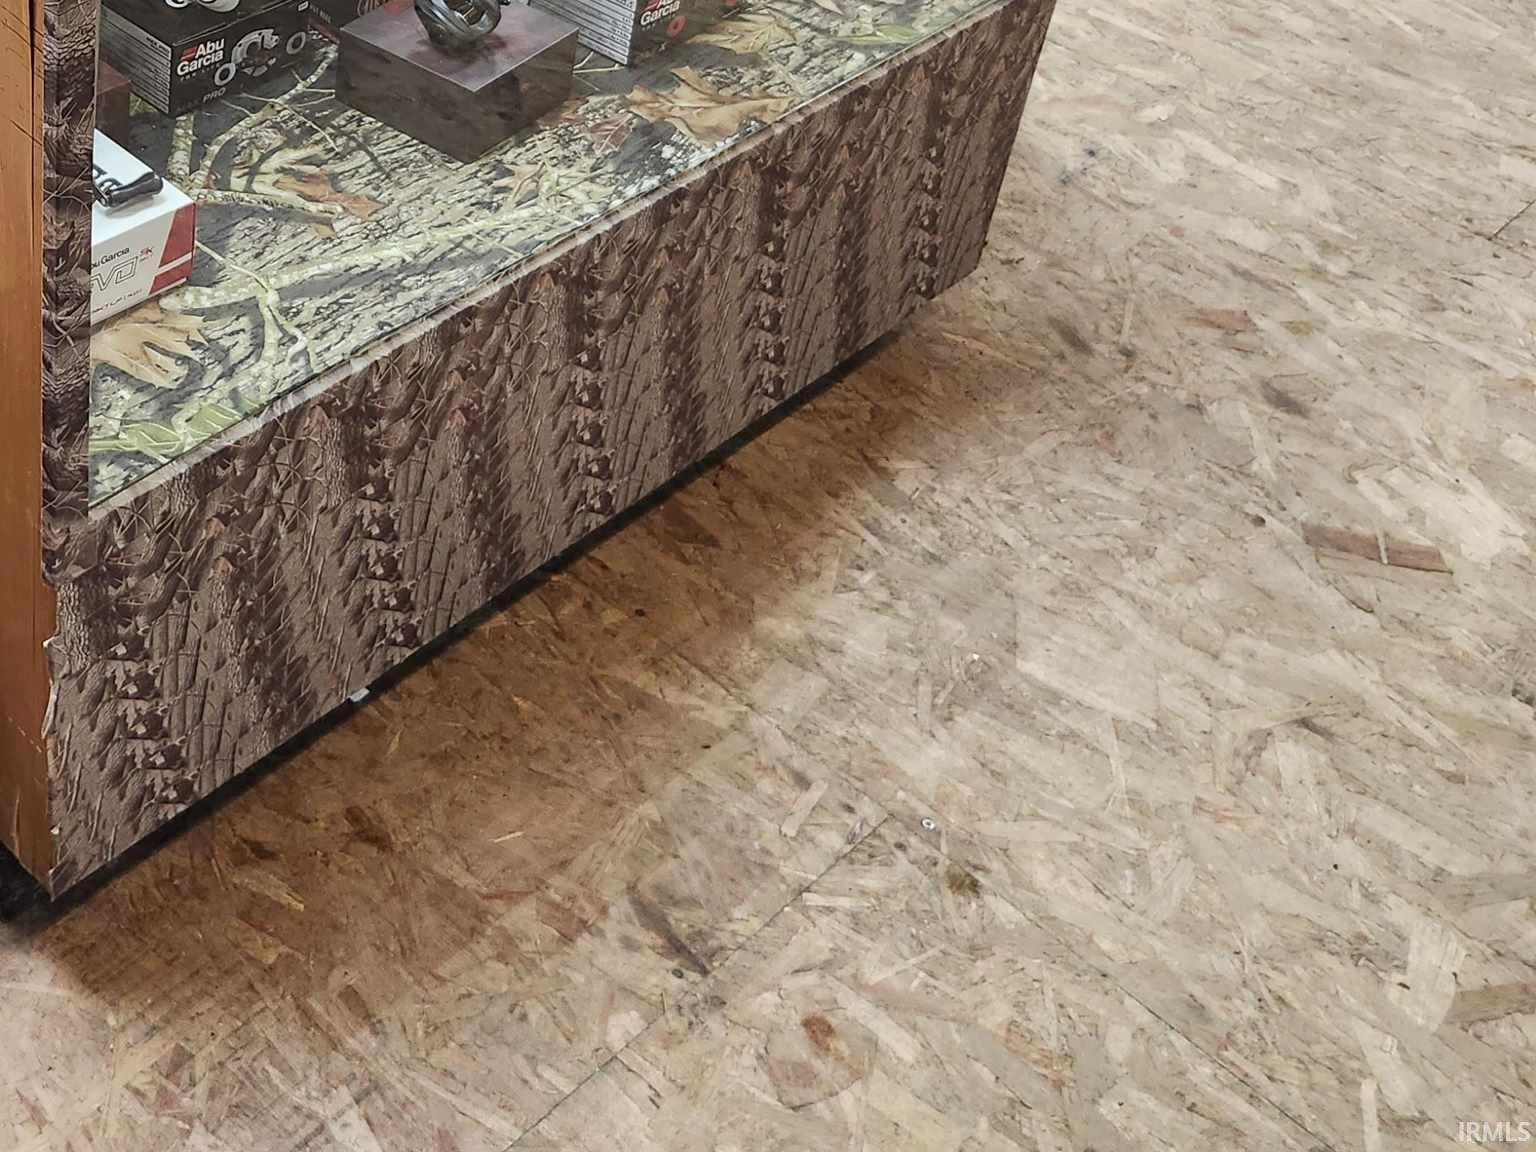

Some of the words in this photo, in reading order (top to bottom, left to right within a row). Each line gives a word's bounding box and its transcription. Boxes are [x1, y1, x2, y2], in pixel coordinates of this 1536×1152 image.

[640, 0, 681, 27] Garcia
[195, 37, 225, 59] Abu
[176, 49, 224, 77] Garcia
[100, 246, 131, 267] Garcia
